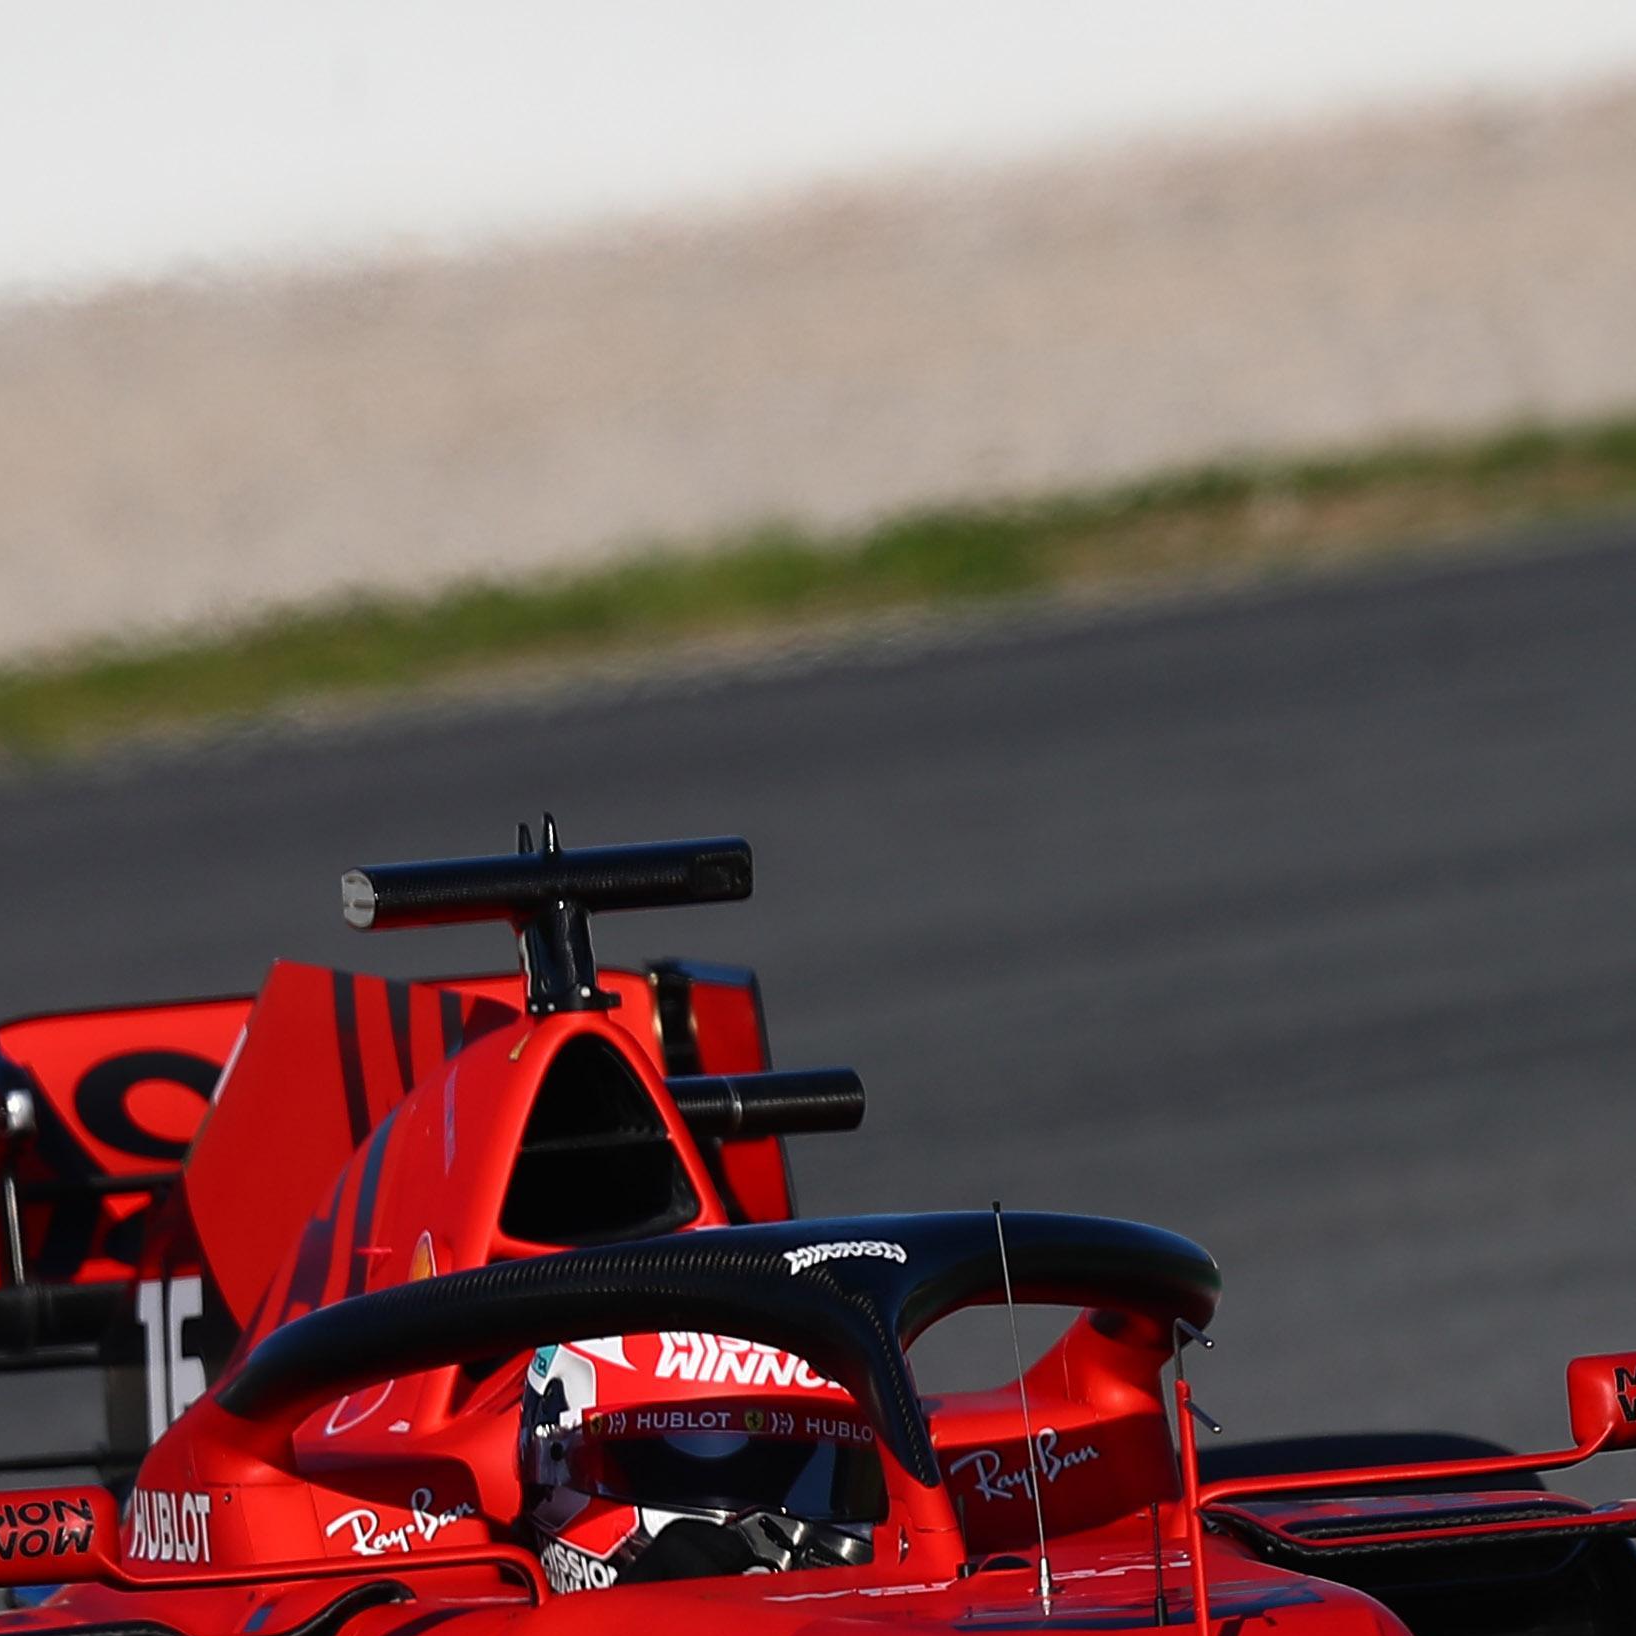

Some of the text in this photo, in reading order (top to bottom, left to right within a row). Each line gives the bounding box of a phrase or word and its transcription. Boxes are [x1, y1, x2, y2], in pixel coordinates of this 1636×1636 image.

[655, 1350, 850, 1392] WINNO
[636, 1411, 874, 1442] HUBLOT HUBLO
[949, 1427, 1100, 1502] Ray-Ban
[127, 1487, 211, 1563] HUBLOT
[326, 1487, 476, 1556] Ray-Ban
